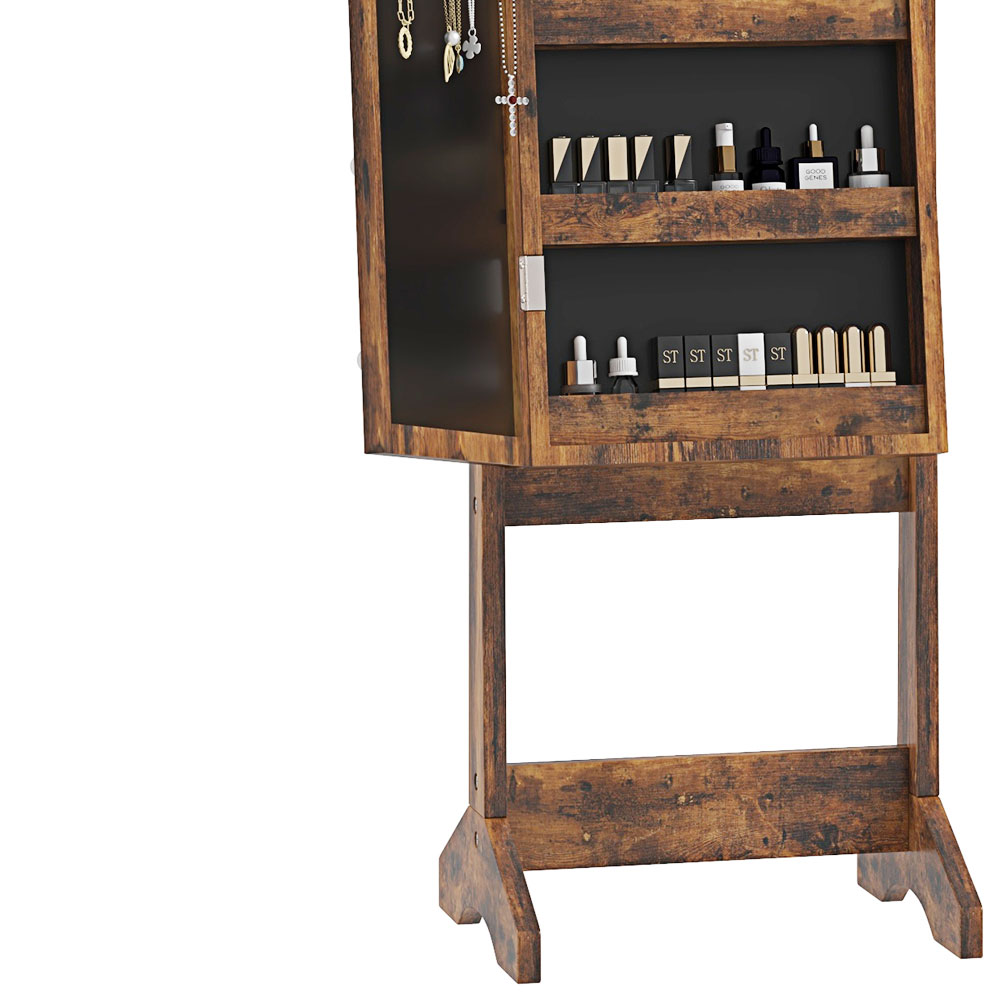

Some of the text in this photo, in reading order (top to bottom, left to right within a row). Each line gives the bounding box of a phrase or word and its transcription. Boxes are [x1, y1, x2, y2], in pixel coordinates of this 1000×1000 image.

[662, 349, 679, 364] ST
[689, 348, 706, 363] ST
[716, 348, 733, 362] ST
[743, 347, 760, 362] ST
[770, 346, 787, 361] ST
